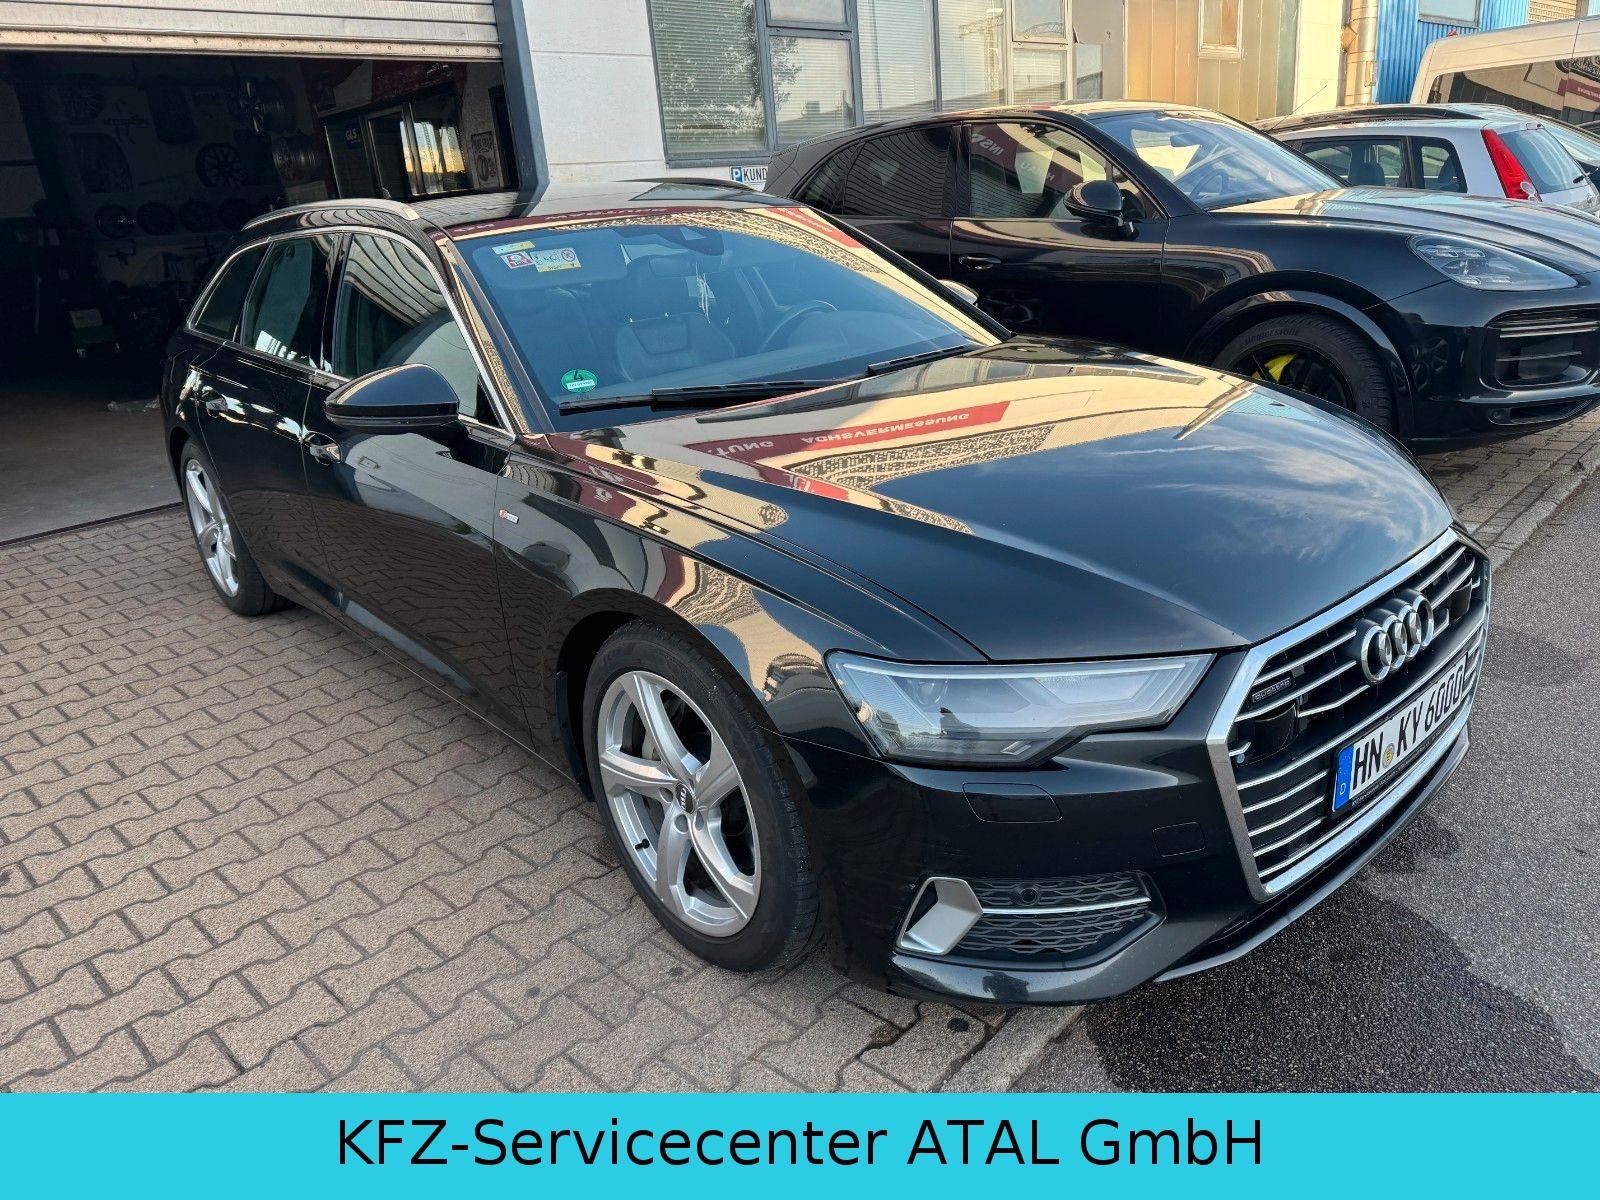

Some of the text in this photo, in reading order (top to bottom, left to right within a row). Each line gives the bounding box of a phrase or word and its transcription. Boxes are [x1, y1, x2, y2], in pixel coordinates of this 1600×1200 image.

[732, 168, 742, 181] P
[1352, 731, 1384, 791] HN
[1396, 700, 1424, 758] KY
[1424, 664, 1464, 732] 6000
[1339, 782, 1347, 796] D
